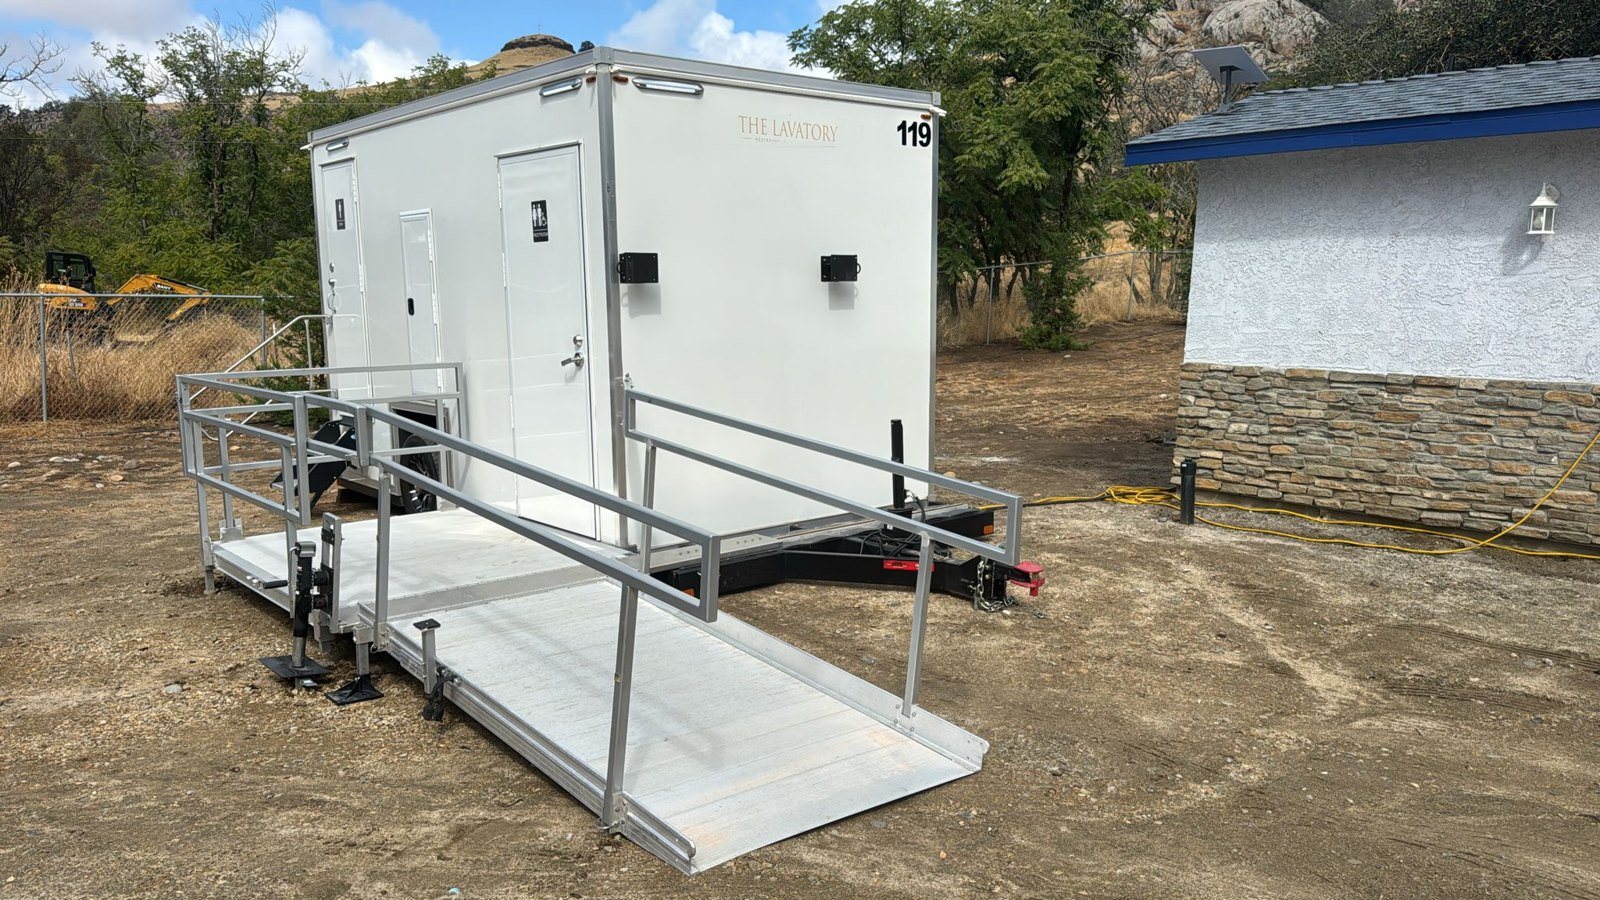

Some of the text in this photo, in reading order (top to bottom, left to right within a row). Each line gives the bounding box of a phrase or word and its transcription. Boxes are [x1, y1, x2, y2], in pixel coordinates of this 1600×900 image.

[738, 115, 838, 142] THE LAVATORY
[897, 120, 931, 147] 119
